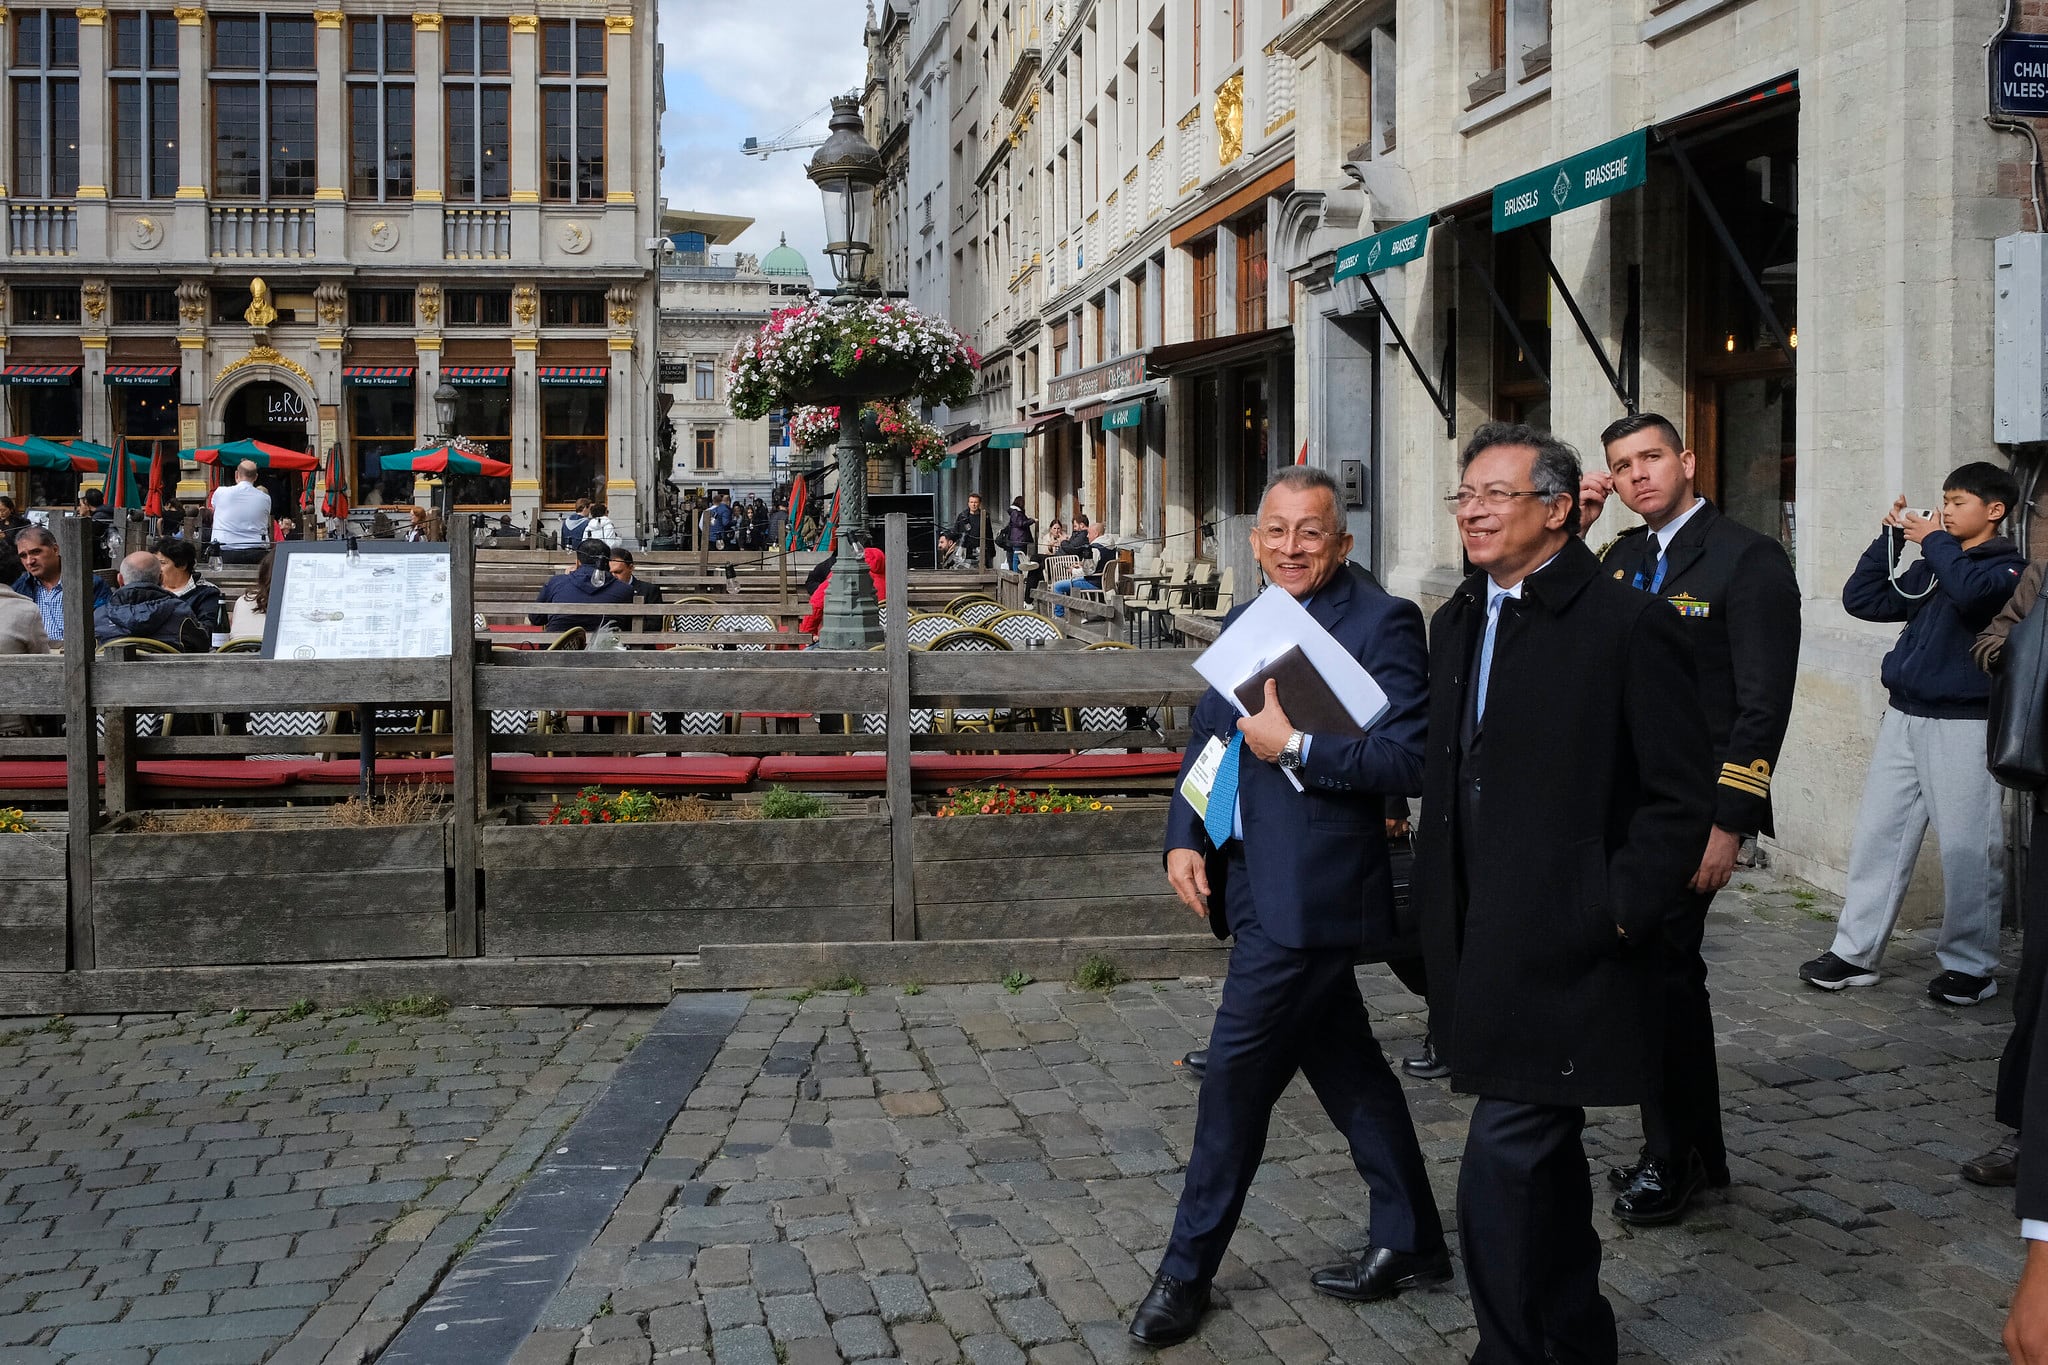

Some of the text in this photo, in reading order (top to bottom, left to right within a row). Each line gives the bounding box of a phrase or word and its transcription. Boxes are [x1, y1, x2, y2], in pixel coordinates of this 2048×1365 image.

[2014, 61, 2048, 78] CHAI
[1504, 189, 1539, 217] BRUSSELS
[1584, 156, 1628, 189] BRASSERIE
[1337, 253, 1359, 273] BRUSSELS
[1391, 234, 1419, 256] BRASSERIE
[268, 392, 304, 415] Le RO
